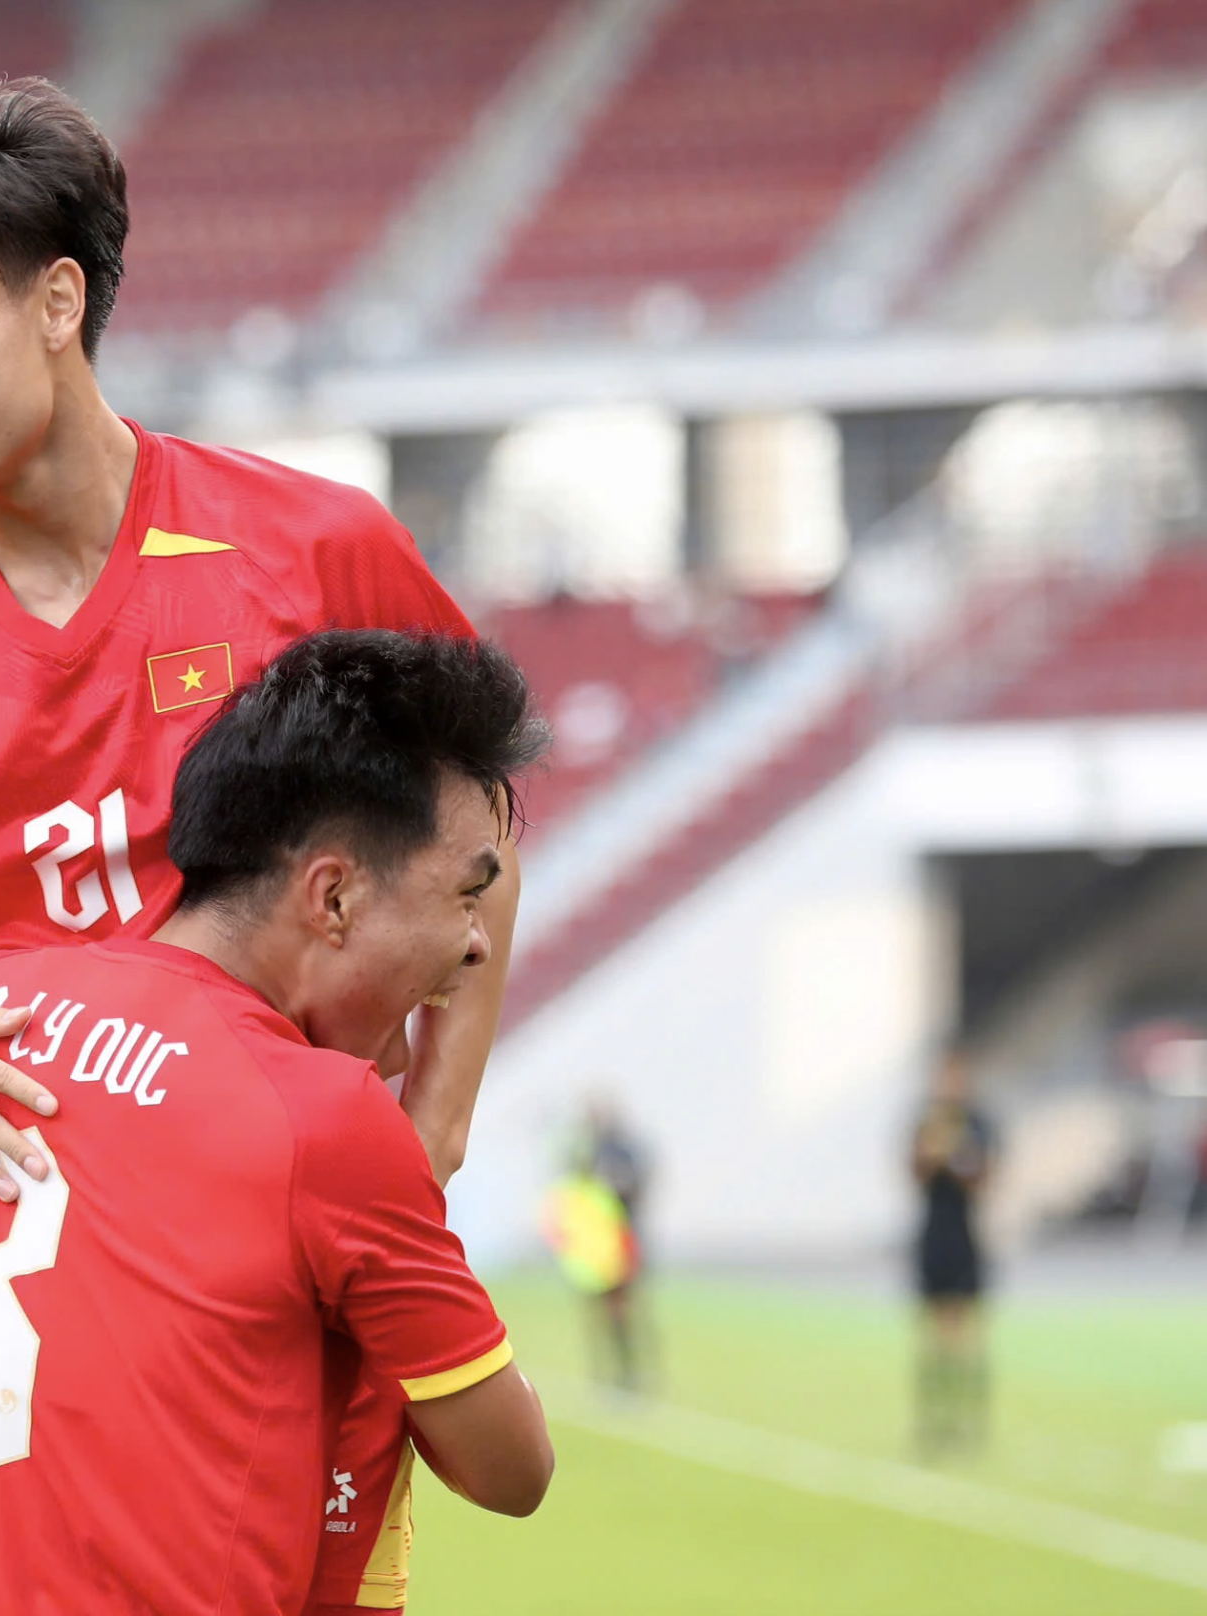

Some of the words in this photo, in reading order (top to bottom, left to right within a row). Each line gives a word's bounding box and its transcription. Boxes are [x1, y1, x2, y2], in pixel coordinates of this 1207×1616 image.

[23, 787, 144, 933] 21
[8, 991, 86, 1065] LY
[69, 1017, 190, 1107] DUC
[325, 1520, 357, 1533] RBOLA
